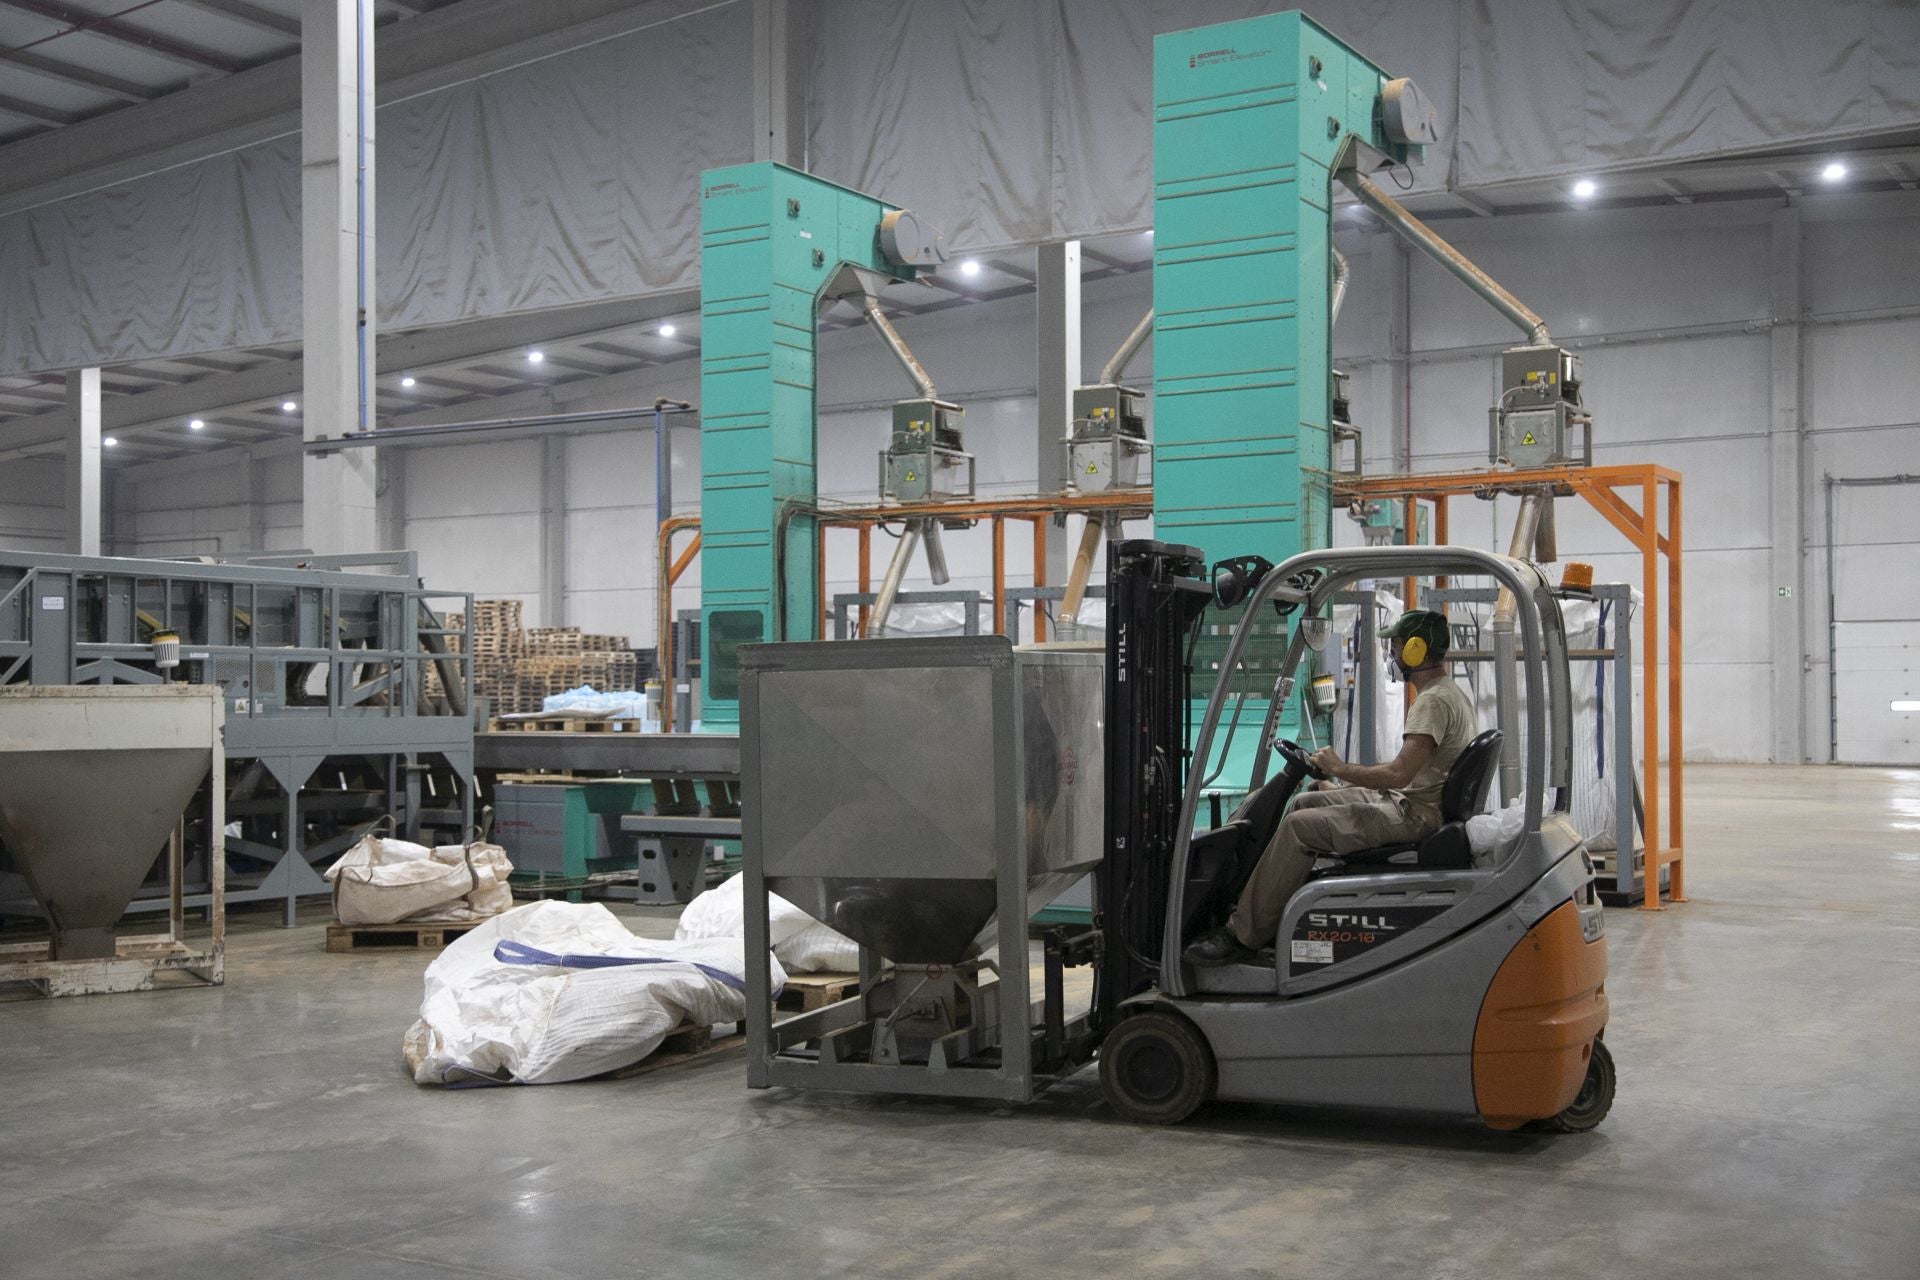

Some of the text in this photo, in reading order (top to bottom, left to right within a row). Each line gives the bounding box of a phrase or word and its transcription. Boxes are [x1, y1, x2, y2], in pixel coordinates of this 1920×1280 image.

[1118, 623, 1126, 682] STILL
[1308, 913, 1397, 930] STILL
[1307, 930, 1376, 944] RX20-16
